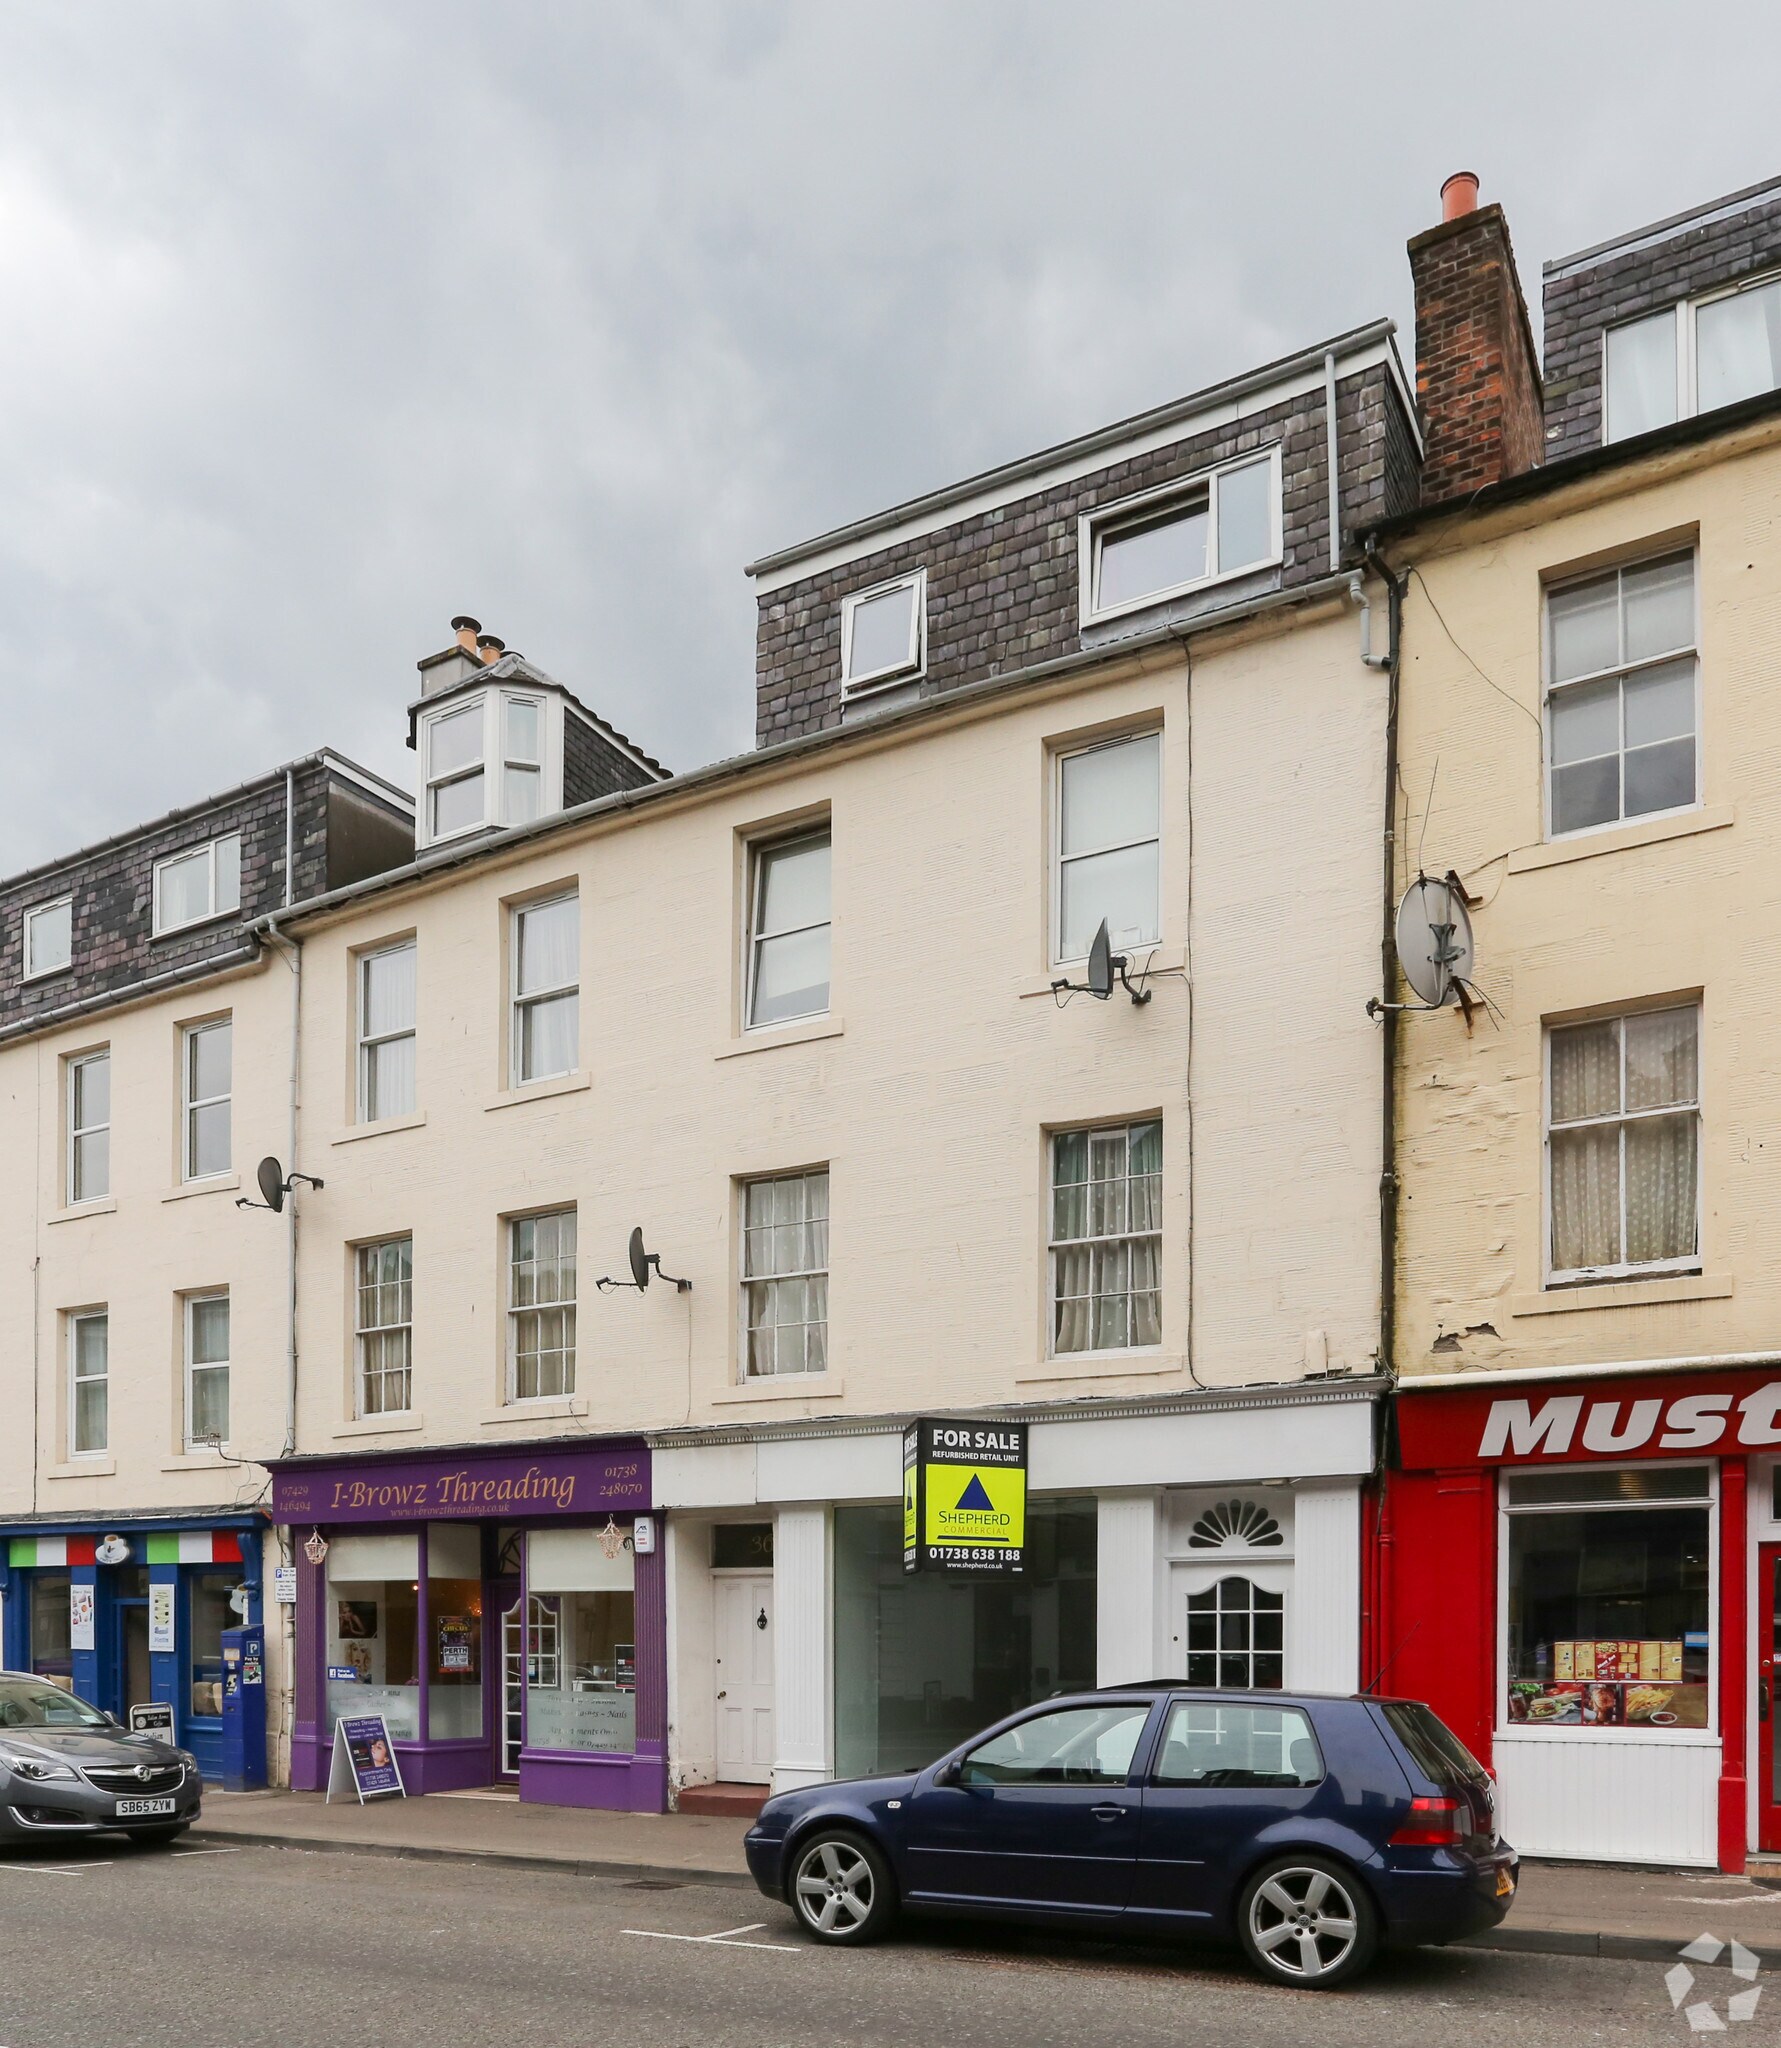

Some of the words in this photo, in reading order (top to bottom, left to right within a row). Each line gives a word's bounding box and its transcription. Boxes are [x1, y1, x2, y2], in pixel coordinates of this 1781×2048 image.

[1477, 1382, 1781, 1457] Must
[933, 1429, 971, 1448] FOR
[974, 1431, 1020, 1450] SALE
[932, 1450, 979, 1460] REFURBISHED
[979, 1453, 1003, 1462] RETAIL
[1003, 1454, 1020, 1463] UNIT
[605, 1464, 638, 1478] 01738
[281, 1486, 309, 1497] 07429
[330, 1481, 428, 1508] I-Browz
[436, 1466, 576, 1508] Threading
[600, 1483, 643, 1497] 248070
[944, 1525, 1008, 1535] COMMERCIAL
[929, 1547, 969, 1560] 01738
[971, 1548, 996, 1561] 638
[998, 1549, 1020, 1561] 188
[946, 1561, 1003, 1570] www.shepherd.co.uk
[607, 1710, 628, 1719] Nails
[121, 1801, 150, 1813] SB65
